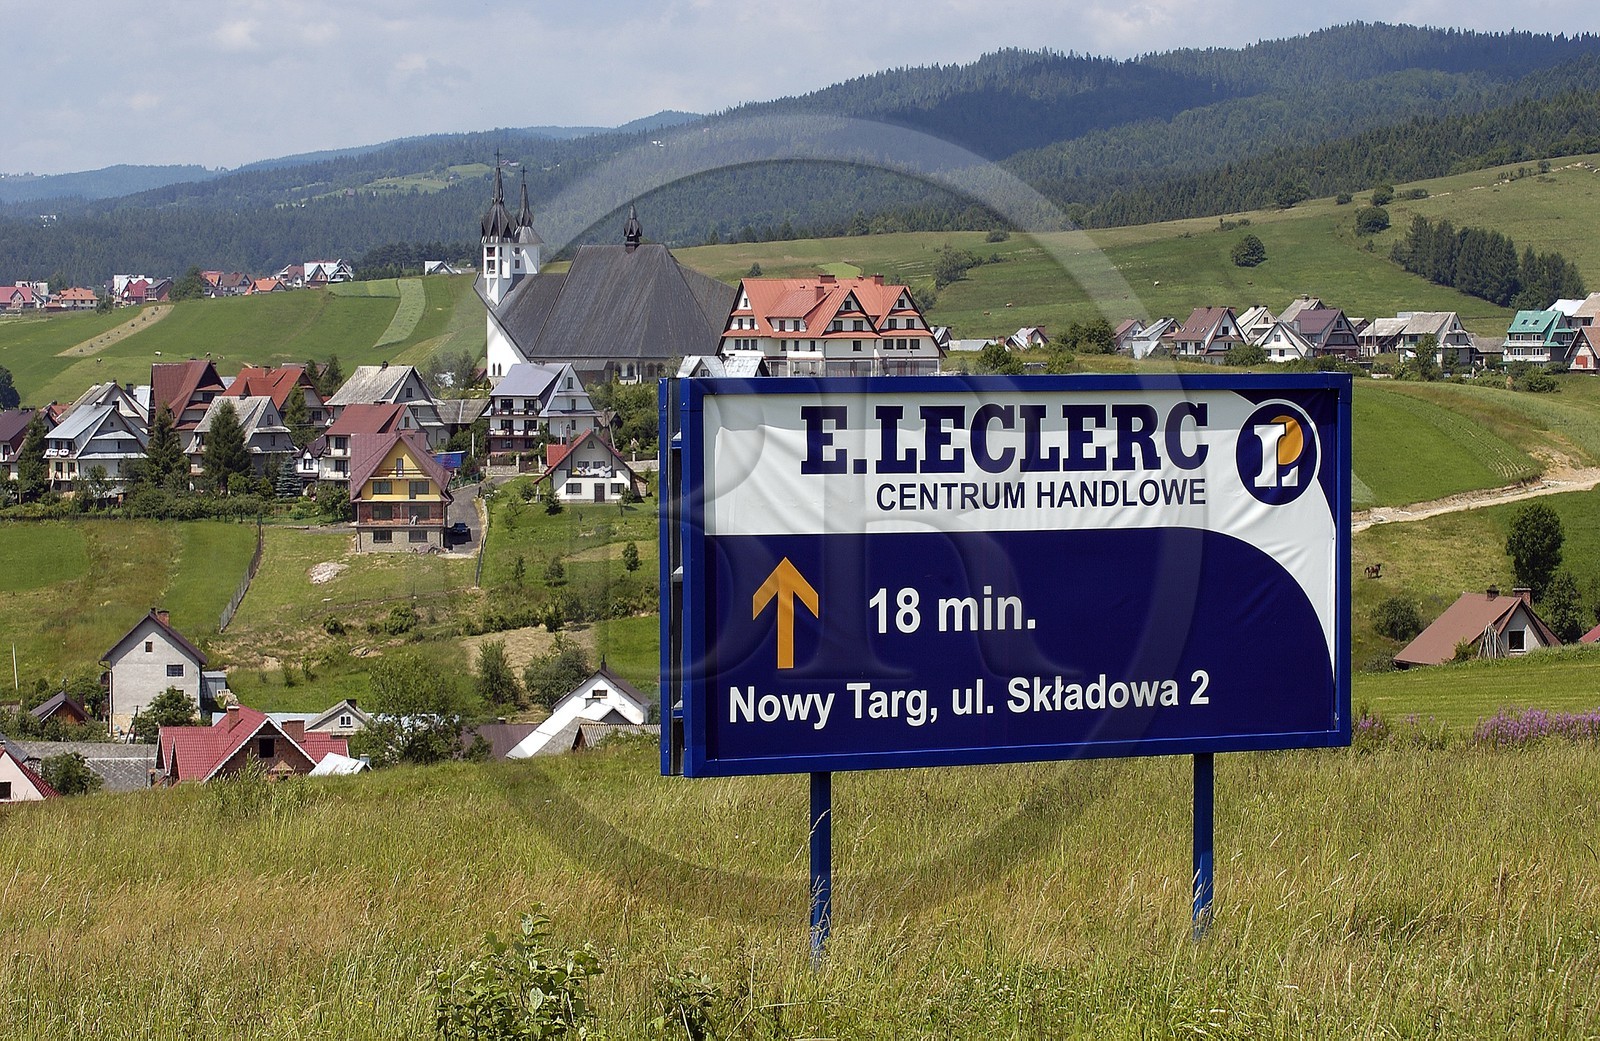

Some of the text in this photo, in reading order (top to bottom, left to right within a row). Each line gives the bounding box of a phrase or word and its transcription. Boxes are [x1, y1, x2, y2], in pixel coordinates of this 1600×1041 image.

[801, 402, 1209, 475] E.LECLERC
[876, 478, 1206, 511] CENTRUM HANDLOWE
[869, 585, 1036, 634] 18 min.
[729, 669, 1210, 730] Nowy Targ, ul. Składowa 2
